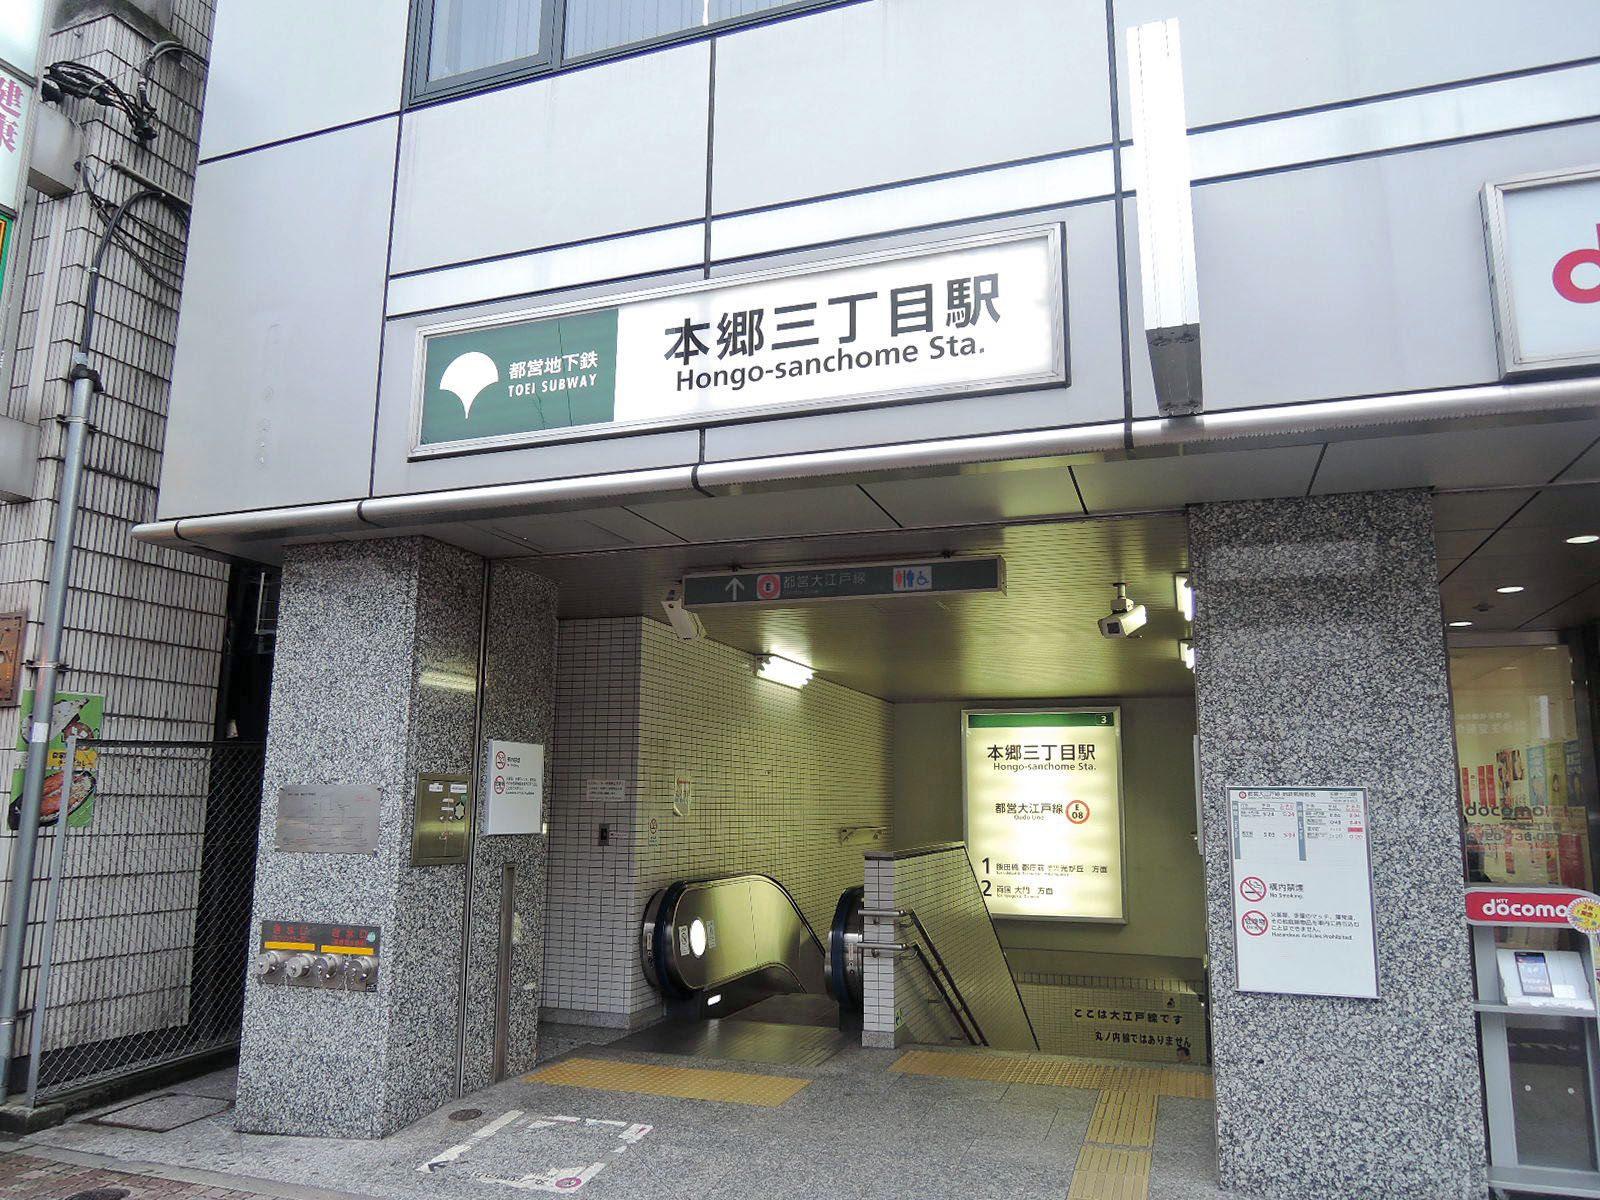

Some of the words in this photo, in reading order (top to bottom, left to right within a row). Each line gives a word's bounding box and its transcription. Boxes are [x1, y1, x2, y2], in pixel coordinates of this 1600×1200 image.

[664, 273, 1000, 366] 本郷三丁目駅
[508, 350, 598, 379] 都営地下鉄
[676, 344, 918, 392] Hongo-sanchome
[929, 335, 985, 360] Sta.
[508, 383, 536, 397] TOEI
[542, 373, 597, 393] SUBWAY
[783, 572, 866, 590] 都営大江戸線
[1101, 715, 1107, 724] 3
[987, 744, 1096, 761] 本郷三丁目駅
[993, 762, 1076, 772] Hongo-sanchome
[1078, 762, 1097, 771] Sta.
[995, 803, 1063, 814] 都営大江戸線
[1071, 811, 1084, 819] 08
[1465, 802, 1545, 817] docomo
[982, 857, 990, 874] 1
[981, 880, 992, 896] 2
[1269, 883, 1303, 892] 構内禁煙
[1482, 898, 1568, 917] docomo
[1074, 1009, 1183, 1025] ここは大江戸線です
[1095, 1031, 1191, 1048] 丸ノ内線ではありません
